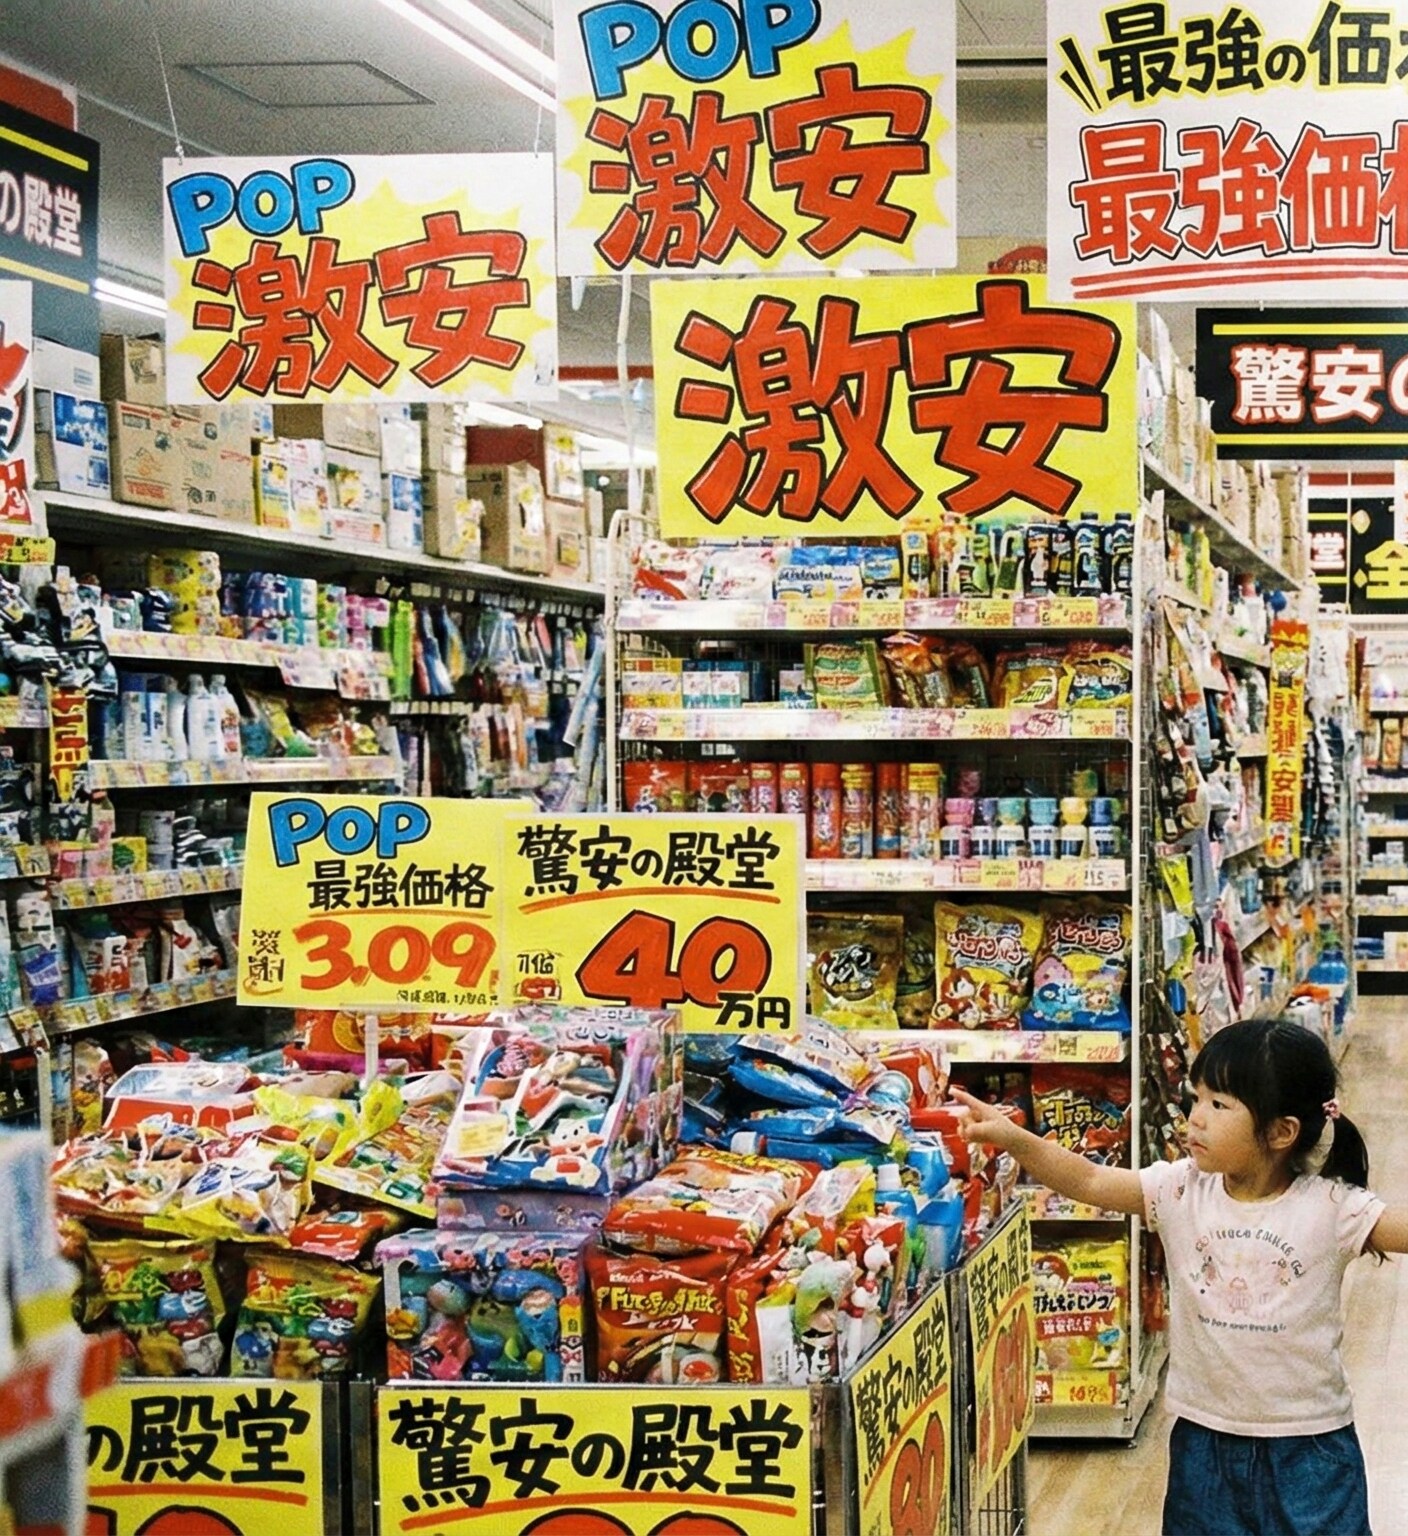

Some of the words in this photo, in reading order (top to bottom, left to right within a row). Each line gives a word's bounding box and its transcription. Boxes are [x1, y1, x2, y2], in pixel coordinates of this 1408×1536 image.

[579, 0, 820, 99] POP
[0, 170, 82, 256] の殿堂
[167, 158, 356, 257] POP
[586, 63, 933, 271] 激安
[194, 211, 530, 401] 激安
[675, 280, 1121, 523] 激安
[268, 797, 431, 868] POP
[517, 825, 781, 897] 驚安の殿堂
[307, 862, 494, 910] 最強価格
[293, 919, 497, 991] 3.09
[575, 909, 773, 1009] 40
[716, 992, 791, 1030] 万円
[88, 1388, 311, 1485] の殿堂
[856, 1298, 948, 1487] 驚安の殿堂
[389, 1397, 804, 1510] 驚安の殿堂
